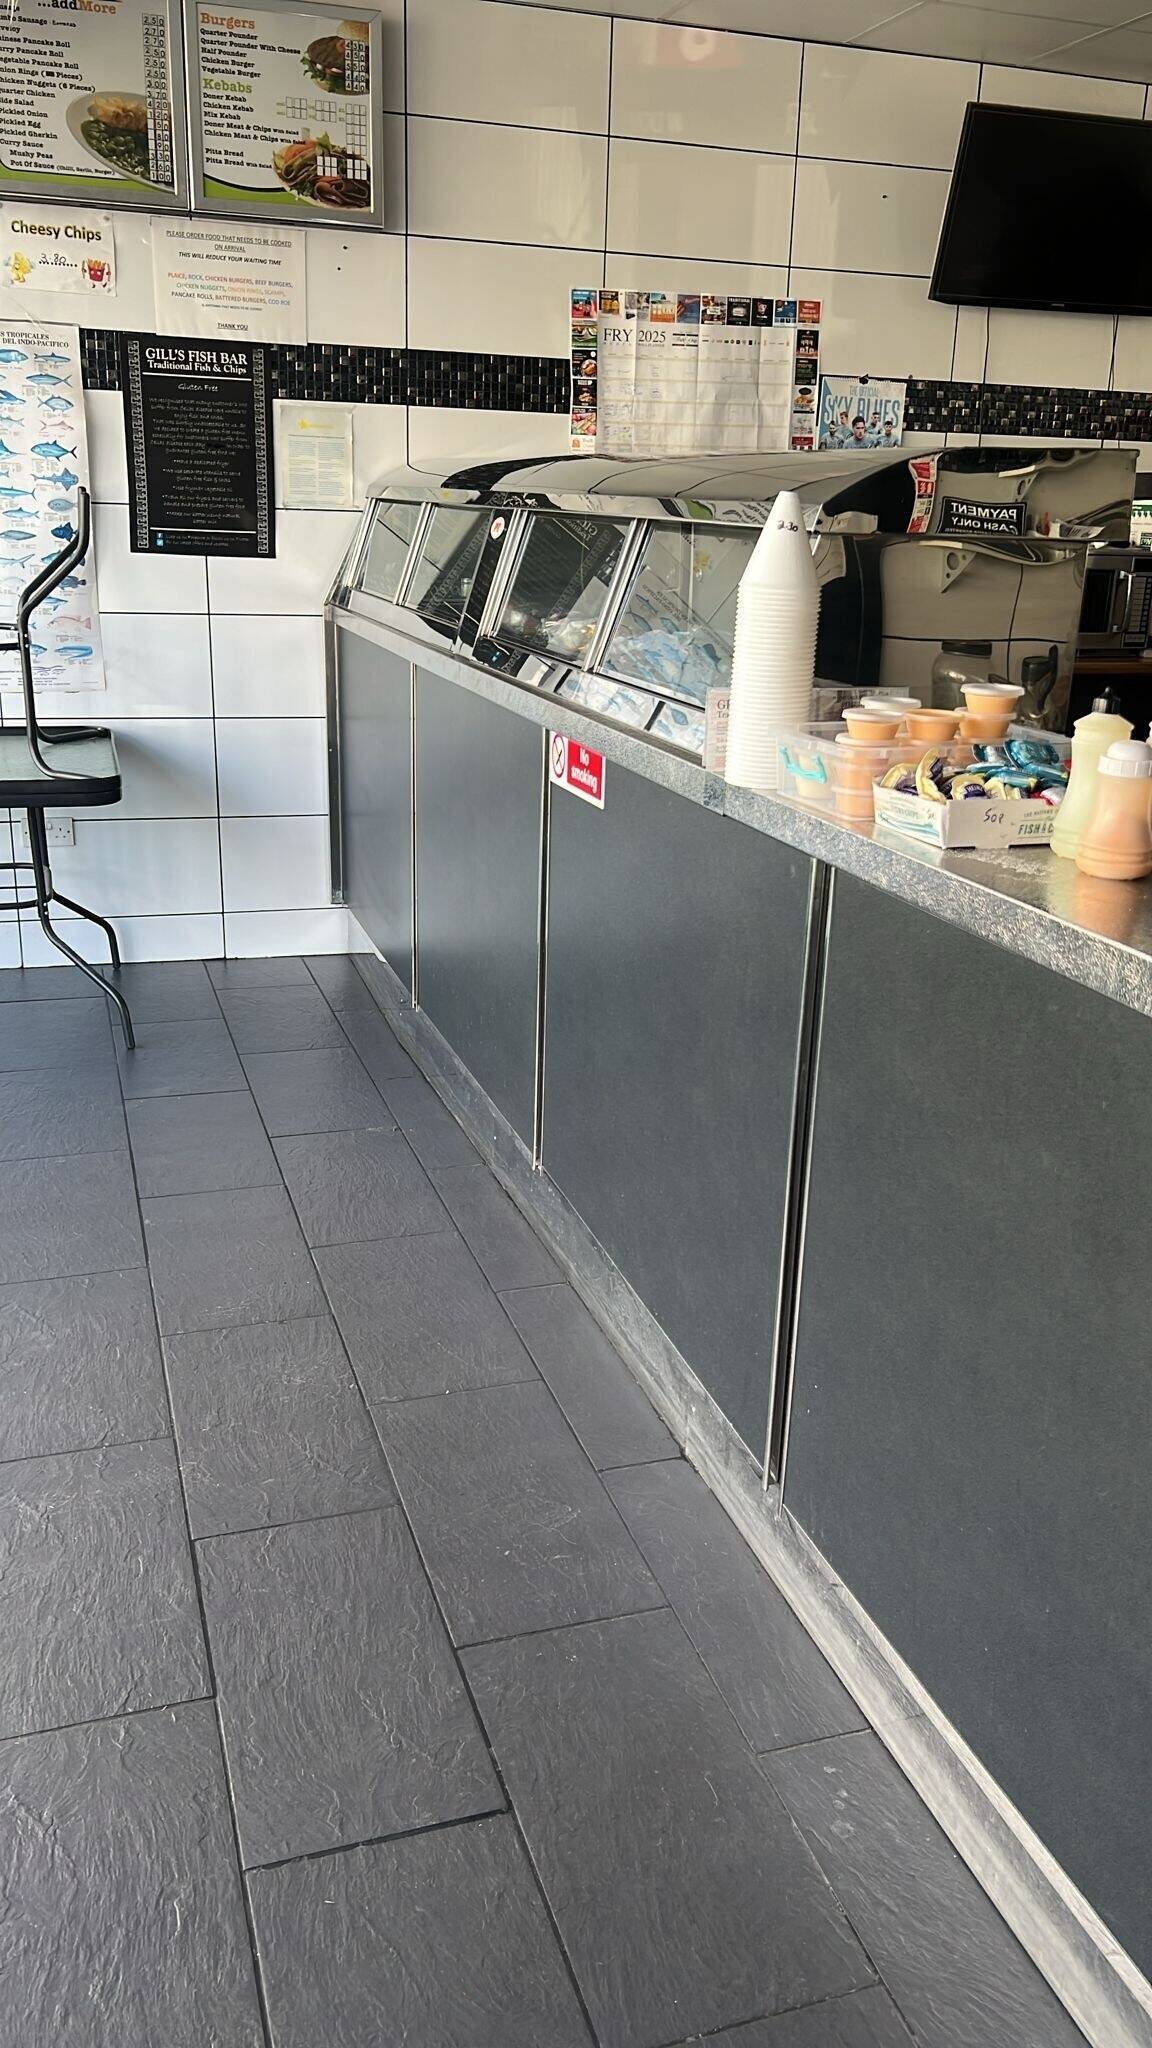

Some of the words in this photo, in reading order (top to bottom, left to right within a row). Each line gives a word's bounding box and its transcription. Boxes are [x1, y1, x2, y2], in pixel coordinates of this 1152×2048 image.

[200, 12, 256, 30] Burgers
[200, 27, 228, 38] Quarter
[228, 30, 258, 41] Pounder
[22, 36, 54, 47] Pancake
[55, 40, 71, 48] Roll
[200, 37, 228, 47] Quarter
[228, 40, 259, 50] Pounder
[259, 43, 277, 53] With
[15, 46, 48, 57] Pancake
[48, 50, 64, 58] Roll
[201, 46, 217, 55] Half
[217, 48, 248, 58] Pounder
[0, 56, 30, 65] egetable
[31, 58, 63, 69] Pancake
[64, 62, 80, 70] Roll
[201, 55, 230, 66] Chicken
[230, 59, 255, 69] Burger
[0, 65, 17, 74] nion
[17, 67, 39, 77] Rings
[201, 65, 236, 76] Vegetable
[236, 69, 262, 79] Burger
[26, 78, 57, 89] Nuggets
[202, 78, 253, 94] Kebabs
[0, 87, 25, 96] uarter
[25, 89, 56, 99] Chicken
[203, 92, 224, 101] Doner
[225, 94, 247, 103] Kebab
[13, 98, 35, 107] Salad
[203, 101, 231, 111] Chicken
[232, 103, 255, 113] Kebab
[26, 110, 48, 119] Onion
[203, 110, 218, 119] Mix
[219, 112, 242, 121] Kebab
[27, 120, 42, 130] Egg
[204, 119, 225, 129] Doner
[226, 121, 245, 131] Meat
[245, 123, 252, 131] &
[252, 124, 272, 133] Chips
[0, 127, 27, 137] Pickled
[27, 131, 58, 140] Gherkin
[204, 129, 232, 138] Chicken
[233, 131, 252, 140] Meat
[252, 133, 259, 141] &
[259, 134, 279, 143] Chips
[0, 138, 21, 148] Curry
[22, 140, 44, 149] Sauce
[9, 149, 35, 159] Mushy
[36, 151, 54, 160] Peas
[205, 147, 222, 156] Pitta
[223, 149, 245, 158] Bread
[10, 159, 23, 168] Pot
[24, 160, 33, 168] Of
[33, 161, 55, 171] Sauce
[205, 156, 223, 165] Pitta
[224, 158, 245, 167] Bread
[11, 220, 61, 240] Cheesy
[64, 225, 102, 243] Chips
[166, 230, 185, 238] PLEASE
[186, 231, 205, 239] ORDER
[205, 233, 221, 241] FOOD
[221, 234, 236, 242] THAT
[236, 236, 254, 244] NEEDS
[254, 237, 262, 245] TO
[262, 238, 269, 246] BE
[270, 239, 292, 248] COOKED
[214, 243, 223, 251] ON
[224, 244, 246, 253] ARRIVAL
[191, 252, 205, 260] WILL
[205, 253, 227, 261] REDUCE
[243, 256, 268, 265] WAITING
[268, 258, 282, 266] TIME
[217, 322, 236, 331] THANK
[236, 323, 249, 331] YOU
[6, 331, 50, 340] TROPICALES
[603, 328, 633, 343] FRY
[638, 330, 667, 344] 2025
[17, 339, 70, 349] INDO-PACIFICO
[145, 347, 185, 361] GILL'S
[188, 350, 218, 363] FISH
[219, 352, 248, 365] BAR
[147, 359, 193, 371] Traditional
[194, 362, 212, 373] Fish
[212, 364, 222, 373] &
[223, 364, 247, 375] Chips
[177, 383, 203, 392] Gluten
[204, 384, 219, 393] Free
[823, 394, 853, 426] SKY
[579, 747, 590, 767] No
[571, 765, 598, 794] smoking
[1018, 823, 1040, 836] FISH
